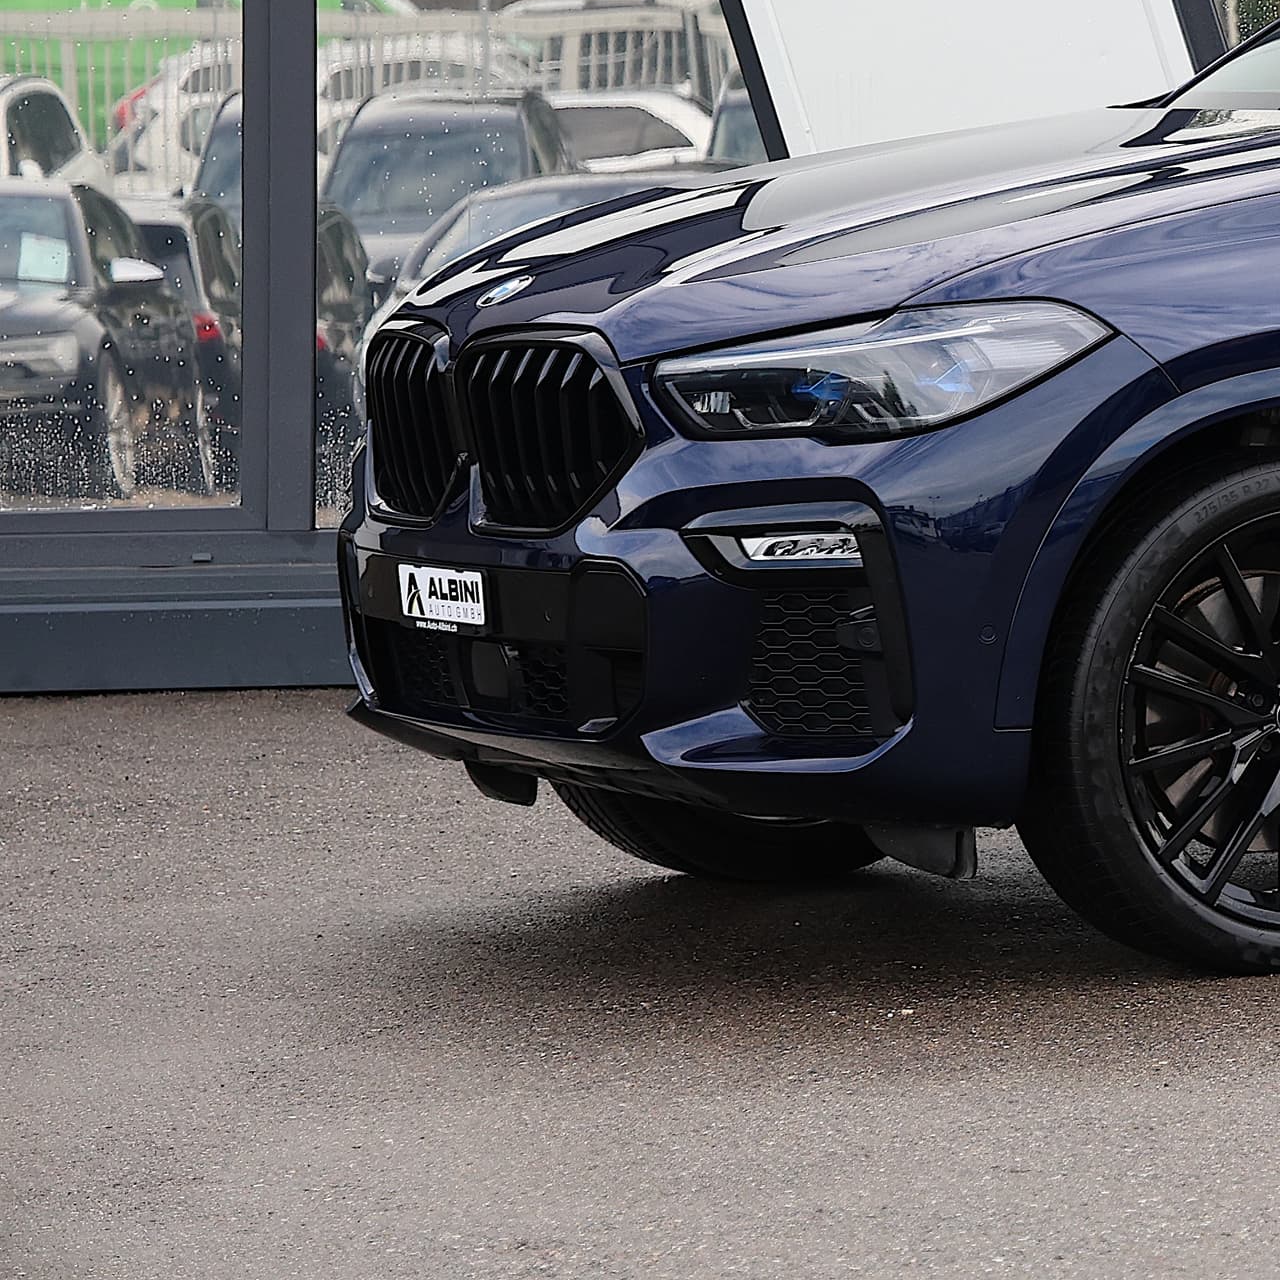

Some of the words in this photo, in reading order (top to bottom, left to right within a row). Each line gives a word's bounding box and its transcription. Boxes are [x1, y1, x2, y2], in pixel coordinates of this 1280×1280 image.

[428, 576, 480, 604] ALBINI
[428, 603, 452, 617] AUTO
[455, 606, 481, 620] GMBH
